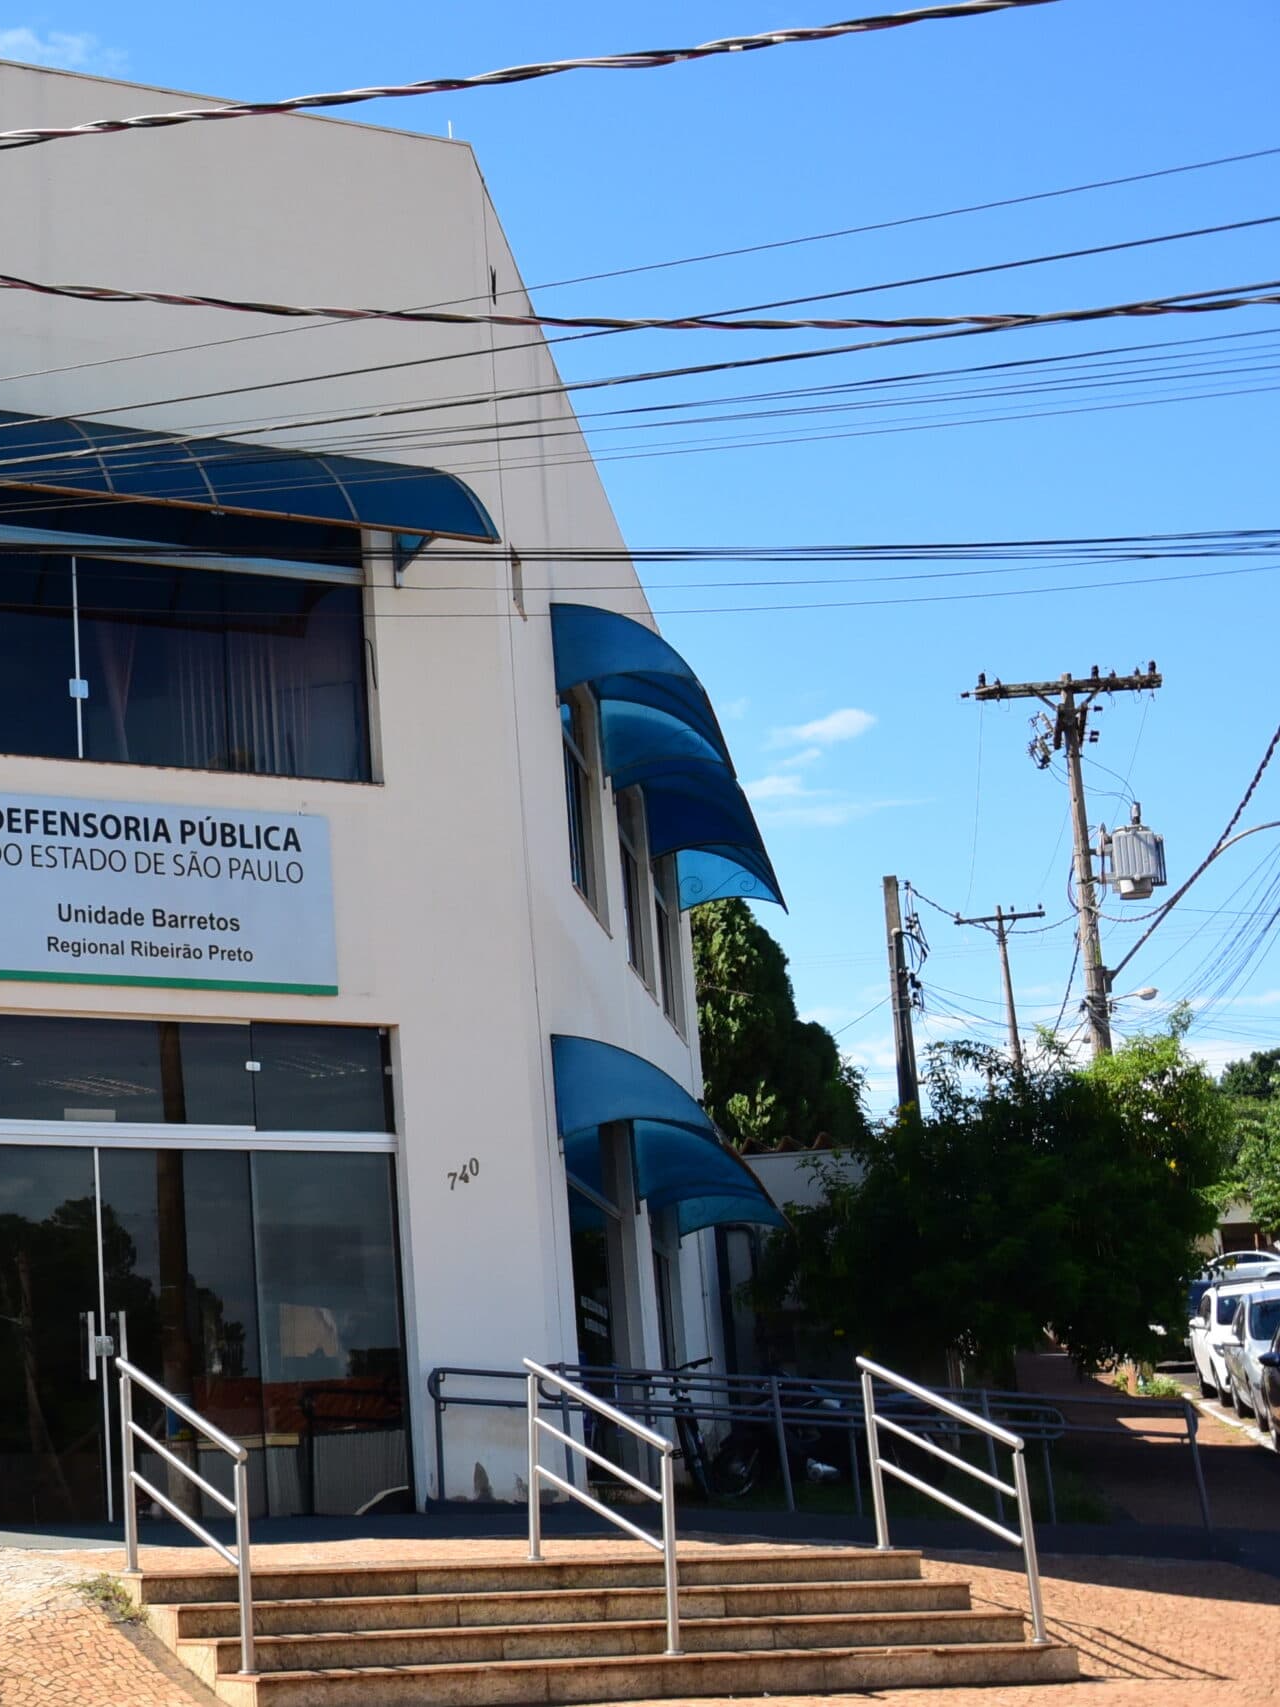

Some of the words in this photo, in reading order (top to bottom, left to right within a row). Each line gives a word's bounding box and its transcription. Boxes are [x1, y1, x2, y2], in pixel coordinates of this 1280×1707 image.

[180, 815, 302, 853] PÚBLICA
[31, 845, 127, 873] ESTADO
[134, 849, 166, 876] DE
[173, 850, 221, 880] SÃO
[229, 857, 305, 885] PAULO
[57, 903, 145, 928] Unidade
[152, 908, 241, 933] Barretos
[46, 936, 125, 961] Regional
[130, 940, 203, 961] Ribeirão
[208, 944, 254, 963] Preto
[447, 1157, 480, 1191] 740
